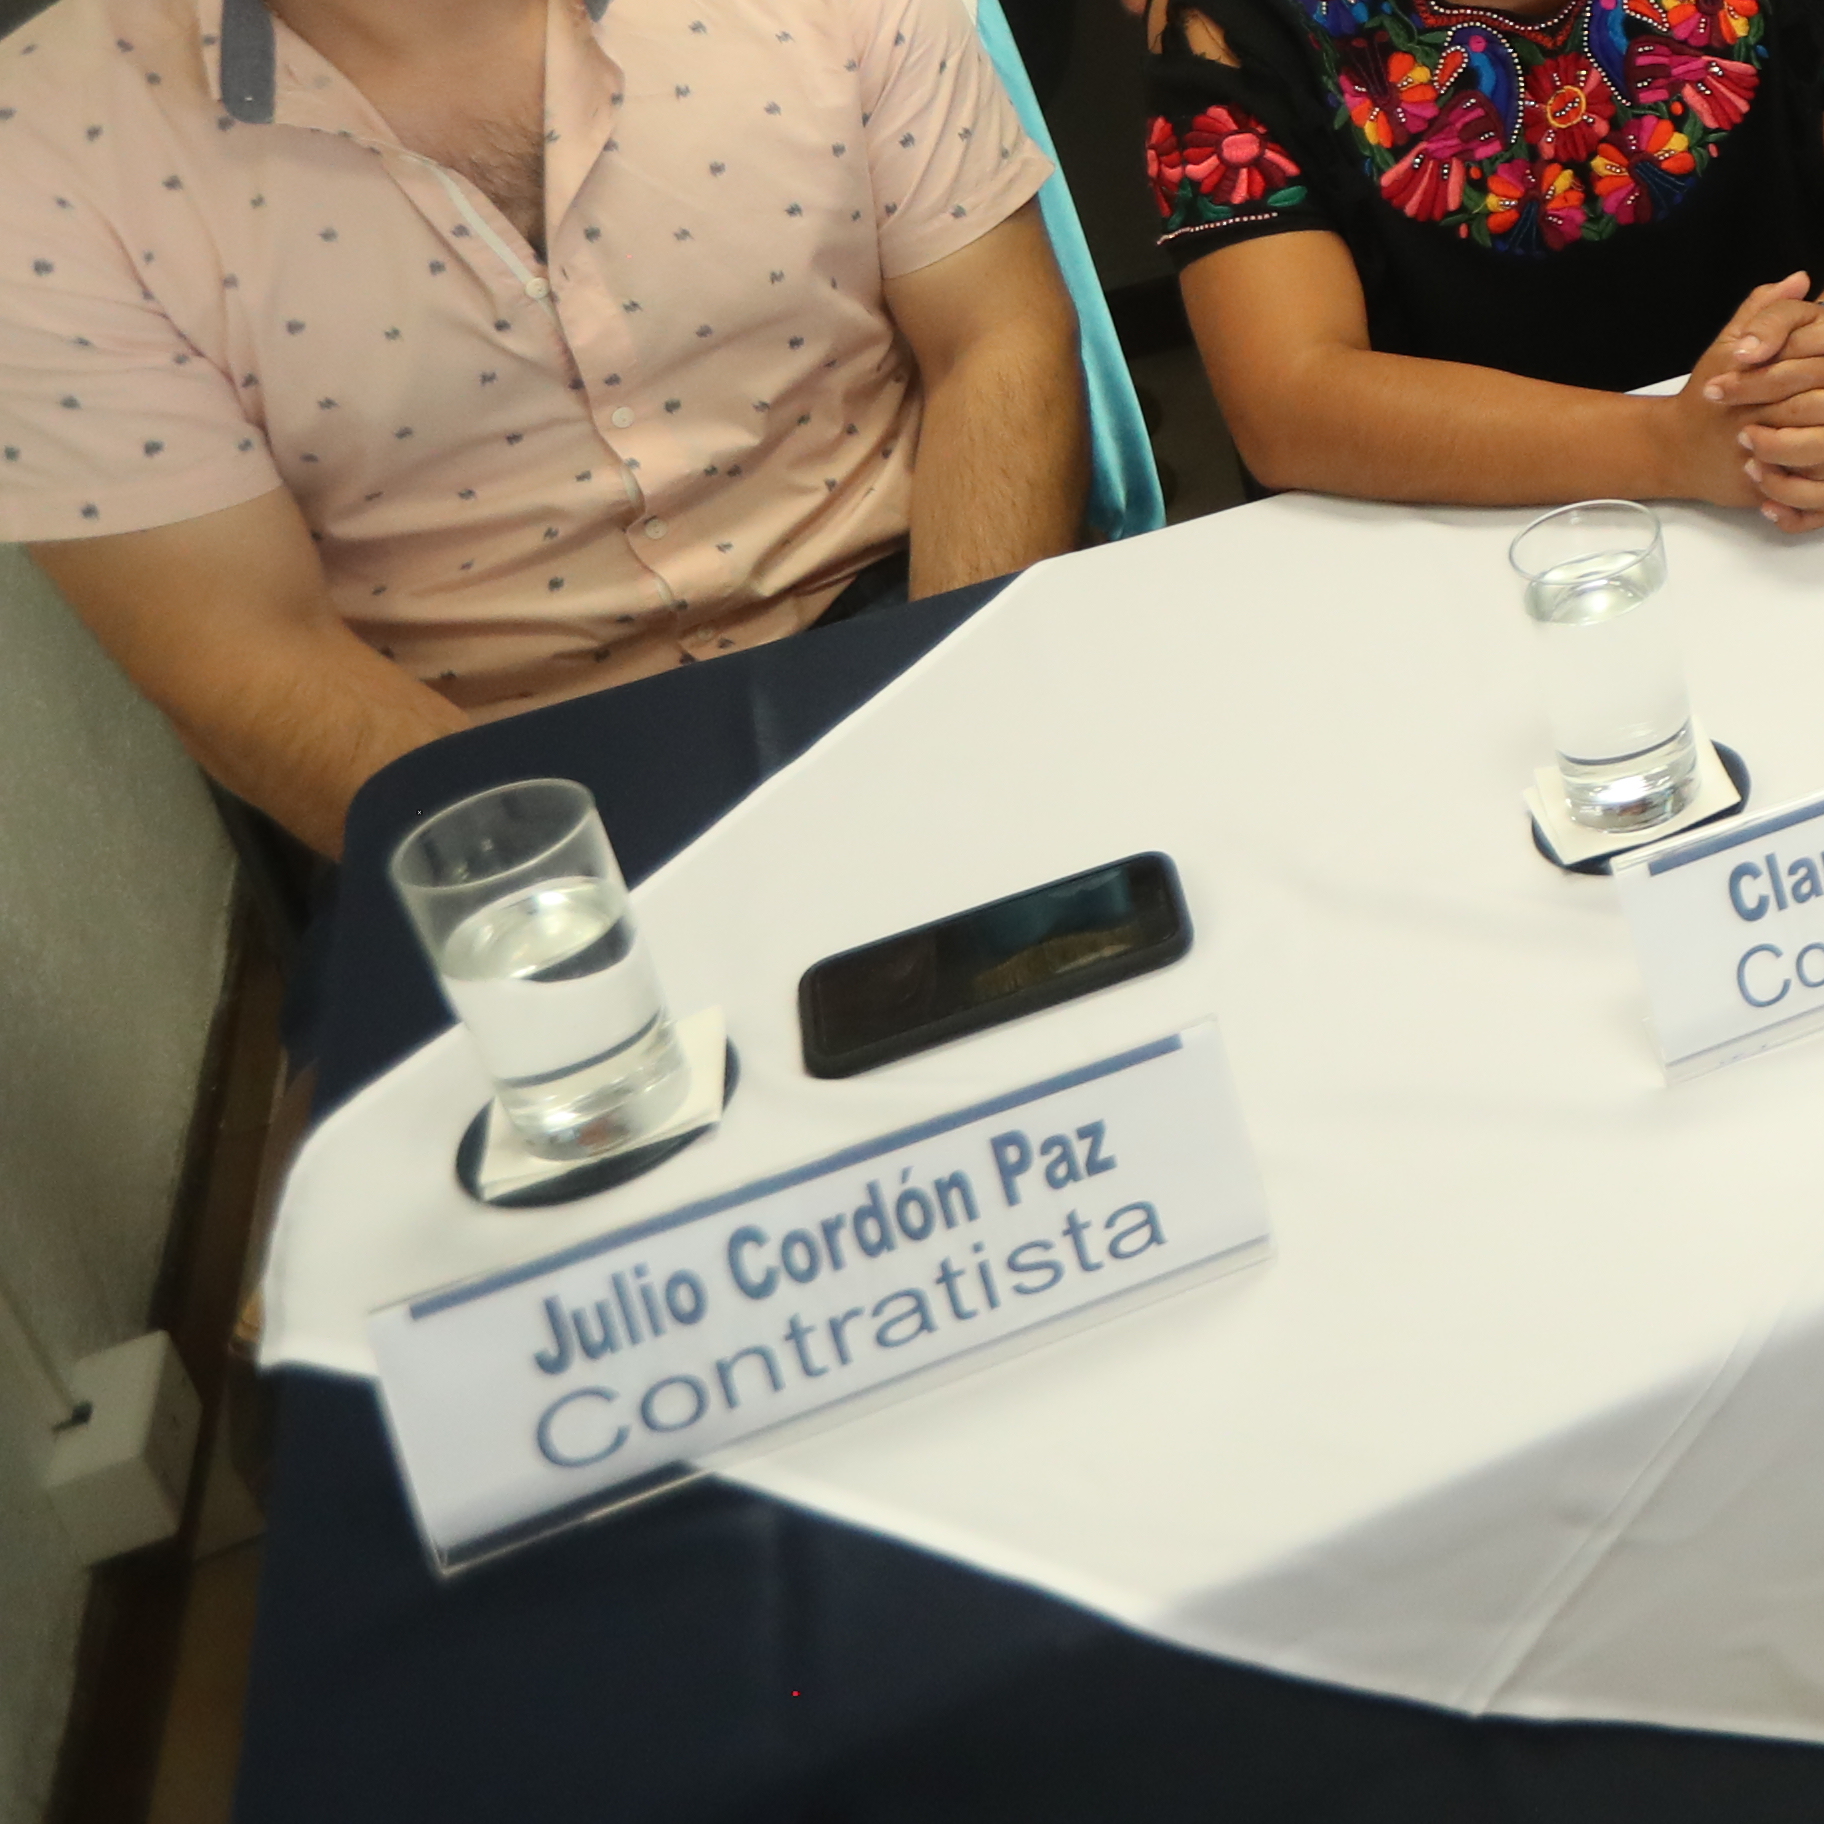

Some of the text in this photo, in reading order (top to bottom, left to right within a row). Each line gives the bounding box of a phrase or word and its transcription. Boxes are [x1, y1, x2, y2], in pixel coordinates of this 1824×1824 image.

[531, 1117, 1118, 1376] Julio Cordón Paz
[534, 1200, 1168, 1469] Contratista
